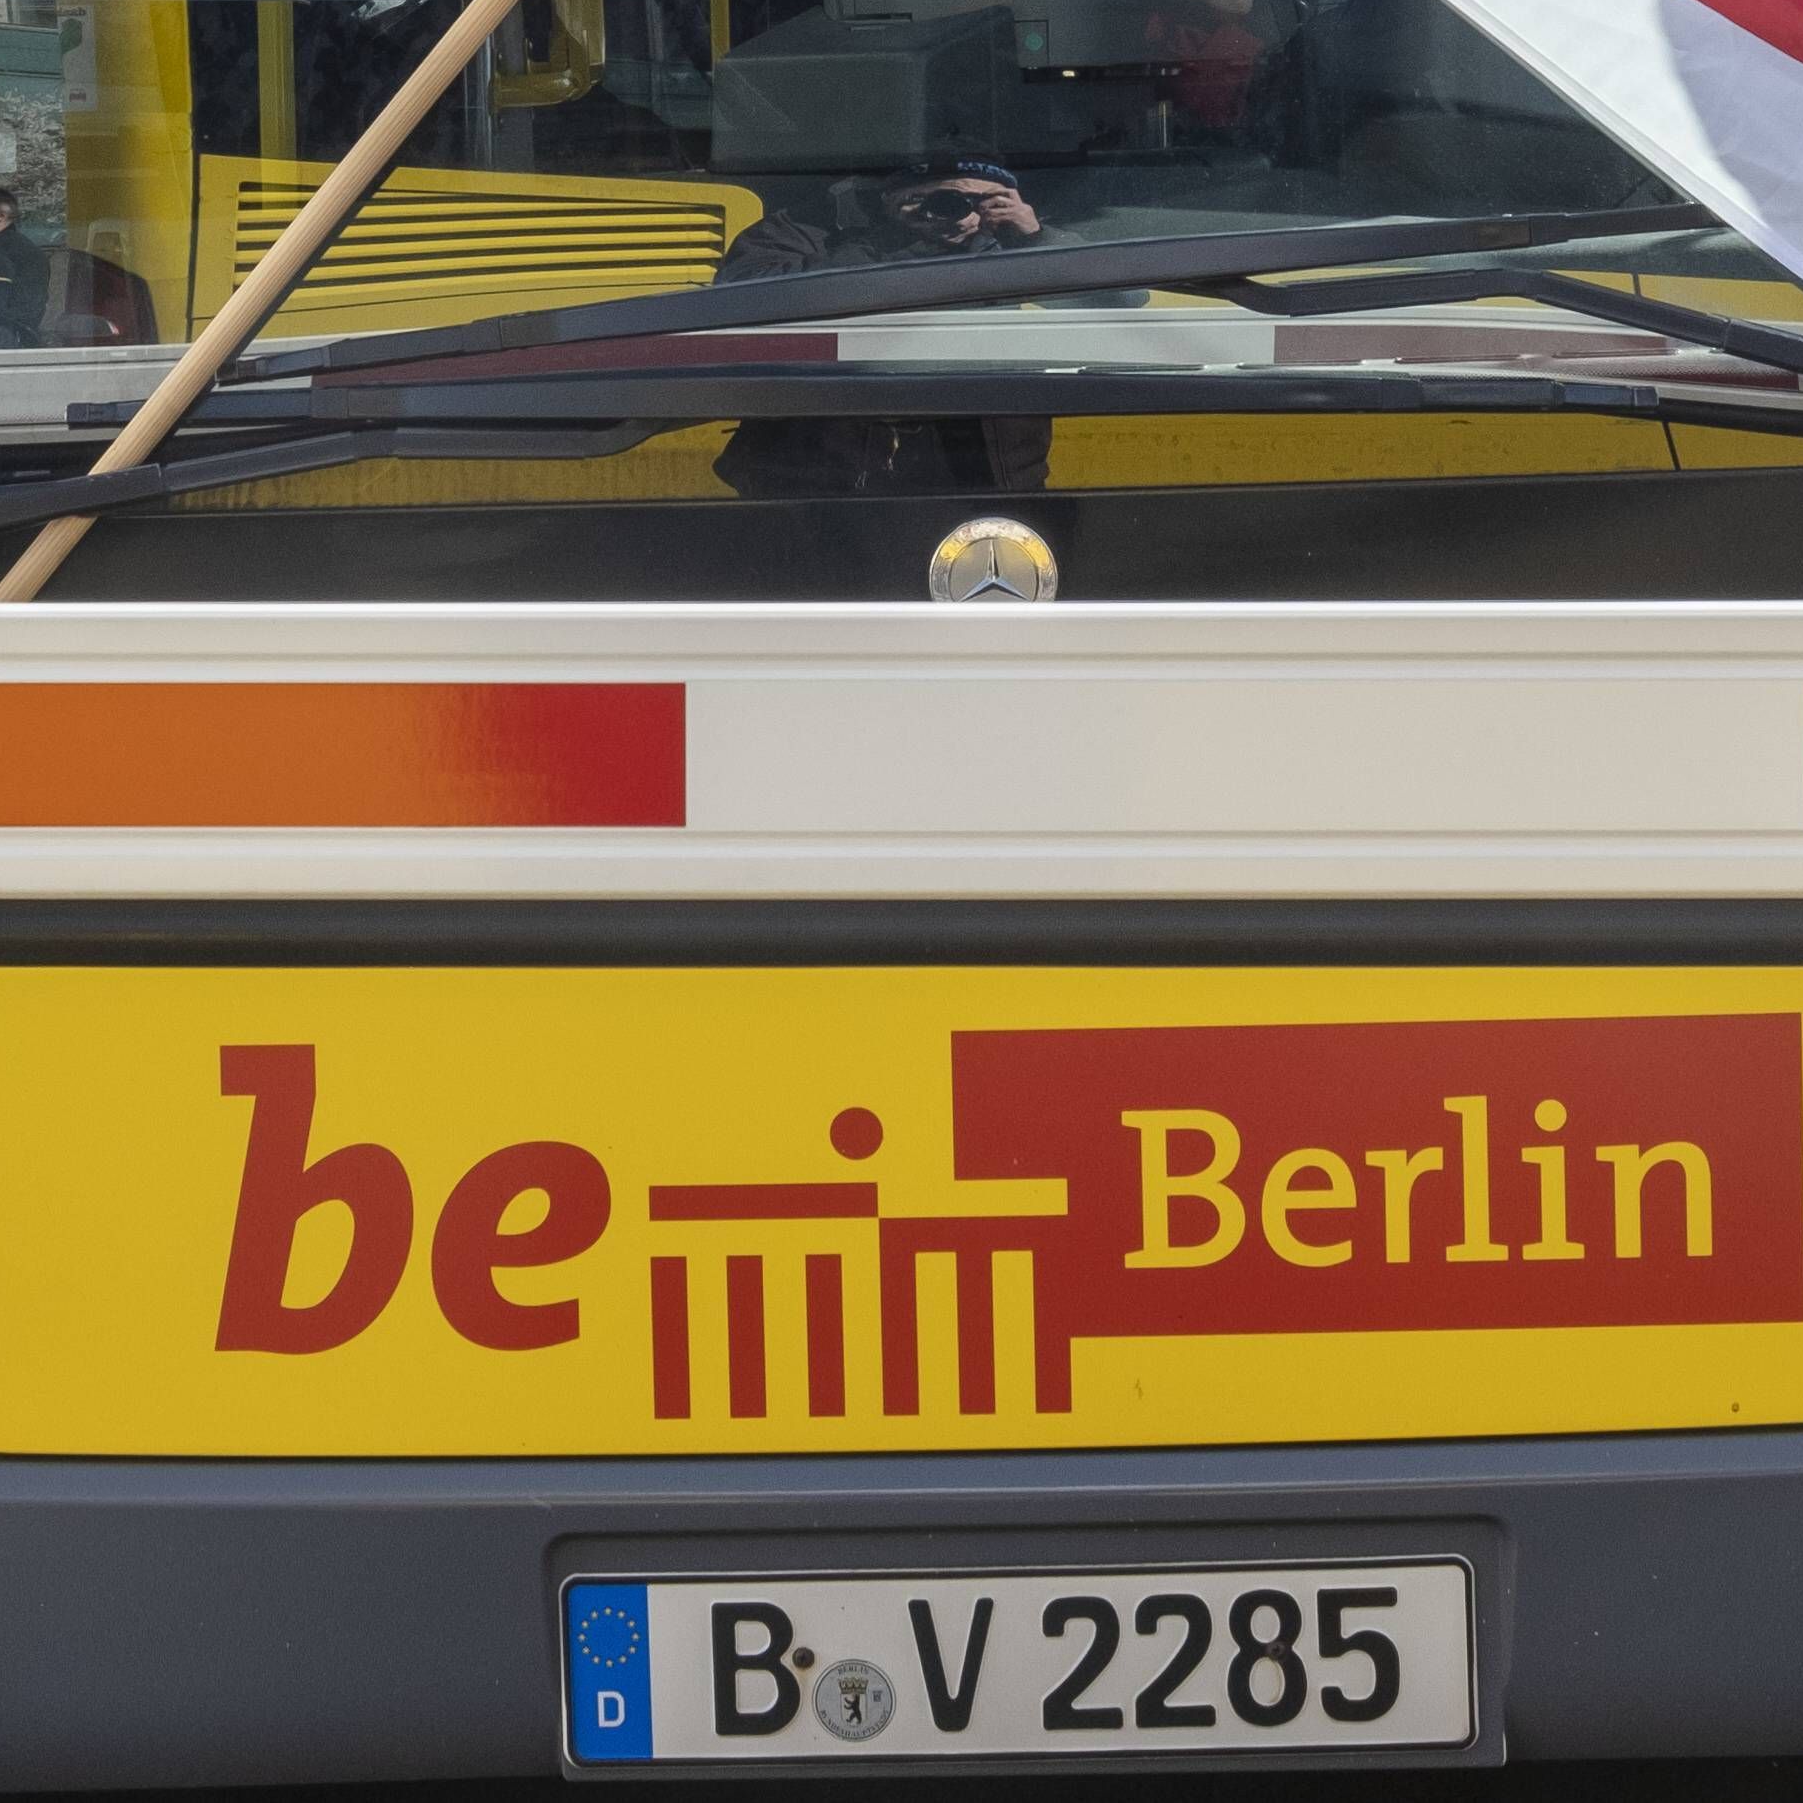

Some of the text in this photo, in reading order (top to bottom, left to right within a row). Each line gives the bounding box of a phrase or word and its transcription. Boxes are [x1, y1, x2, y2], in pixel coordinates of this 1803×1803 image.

[216, 1044, 1714, 1355] be Berlin
[598, 1586, 1399, 1737] D B V 2285
